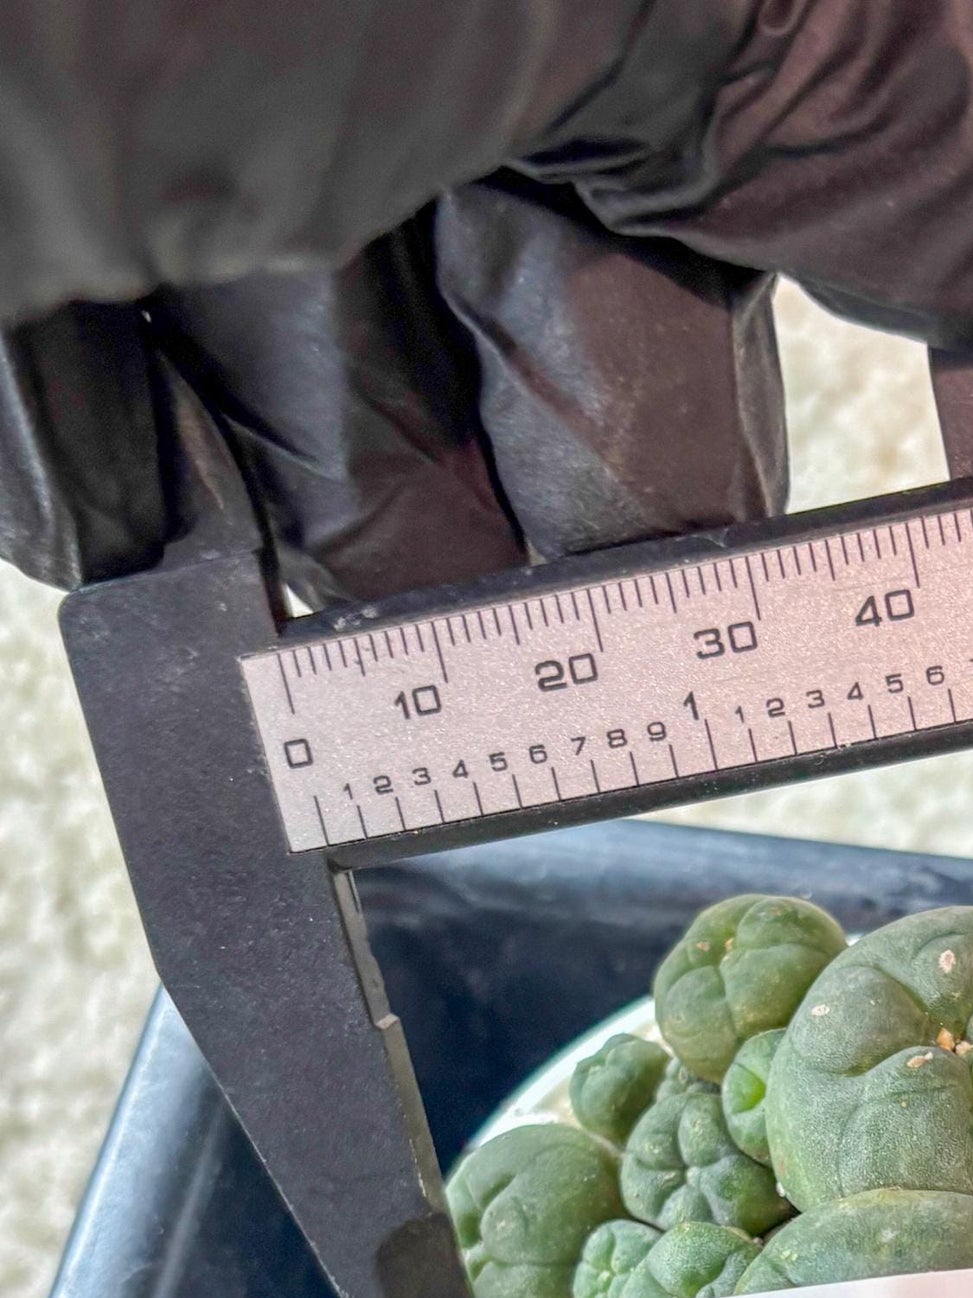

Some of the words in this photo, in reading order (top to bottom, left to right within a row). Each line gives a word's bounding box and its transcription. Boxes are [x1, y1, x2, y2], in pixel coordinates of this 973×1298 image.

[283, 738, 314, 769] 0
[394, 685, 442, 720] 10
[534, 653, 598, 692] 20
[693, 621, 758, 660] 30
[855, 589, 915, 627] 40
[343, 783, 353, 800] 1
[373, 775, 394, 795] 2
[412, 767, 431, 786] 3
[452, 760, 469, 778] 4
[488, 751, 508, 772] 5
[528, 744, 548, 764] 6
[571, 736, 586, 755] 7
[606, 728, 628, 749] 8
[647, 721, 667, 742] 9
[683, 691, 699, 720] 1
[735, 706, 745, 723] 1
[766, 697, 785, 718] 2
[806, 689, 825, 709] 3
[847, 682, 864, 700] 4
[885, 673, 904, 693] 5
[925, 665, 945, 686] 6
